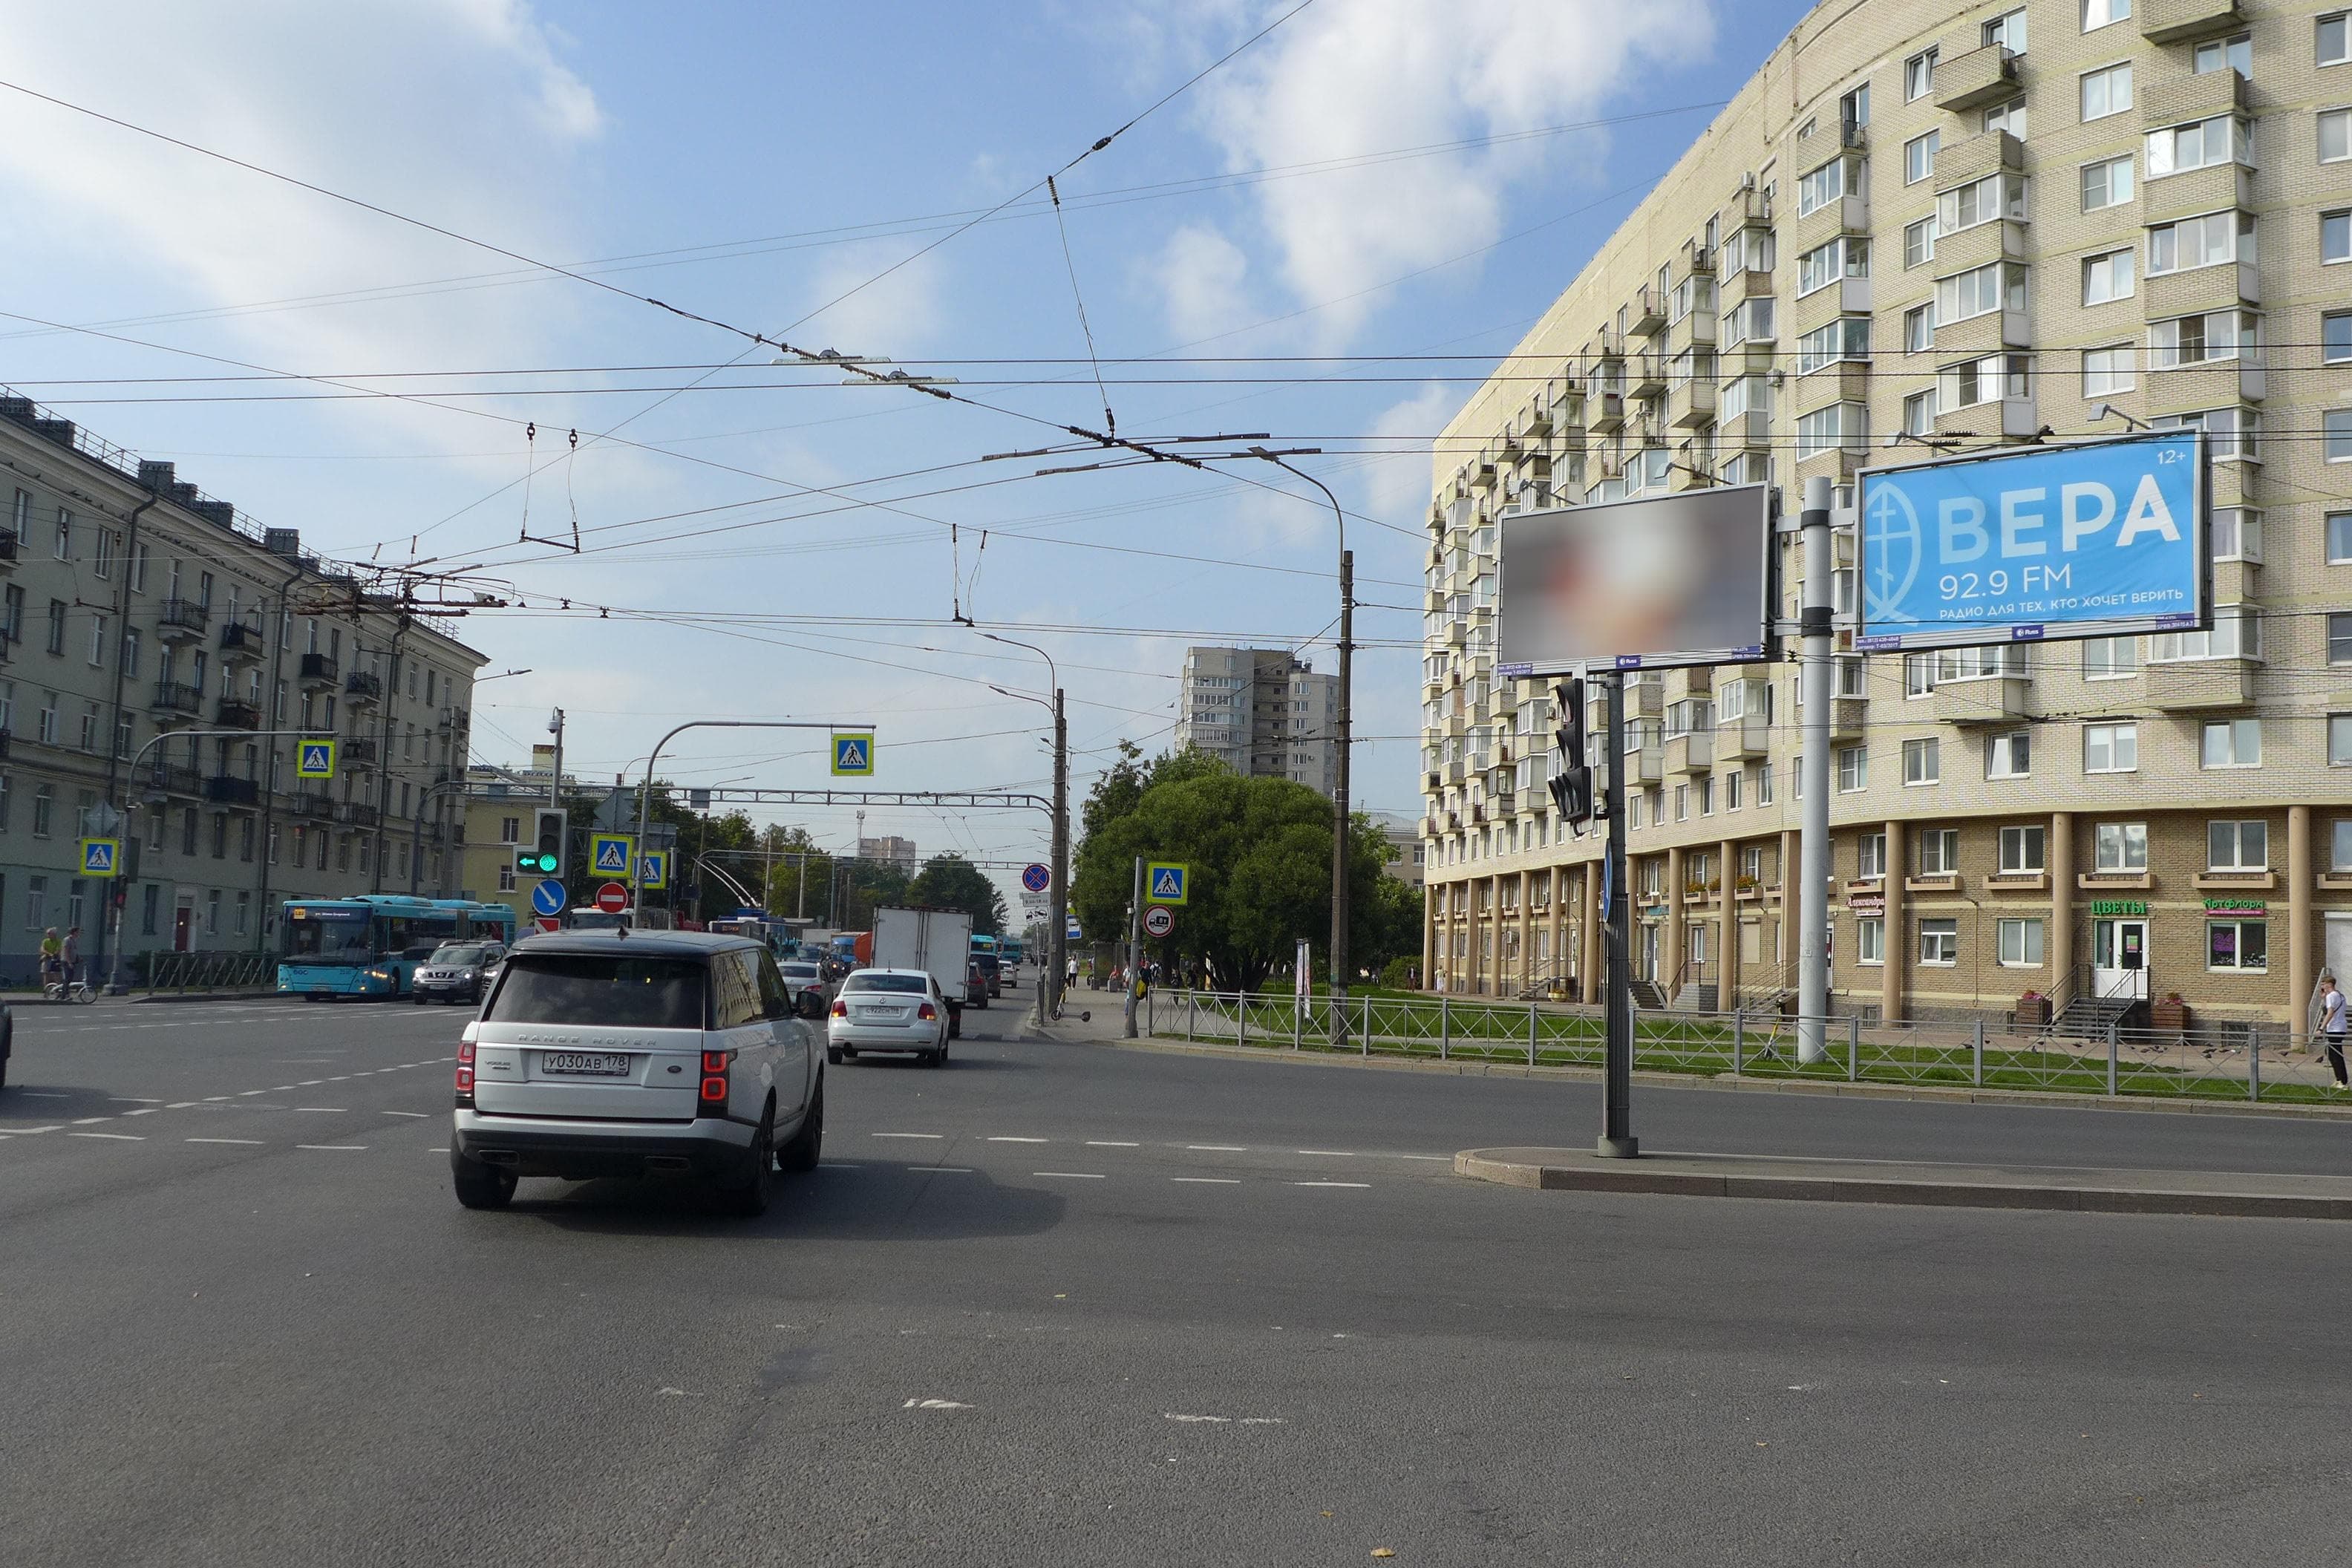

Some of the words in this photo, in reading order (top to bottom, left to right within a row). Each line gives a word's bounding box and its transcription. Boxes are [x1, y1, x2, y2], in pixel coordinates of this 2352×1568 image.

[2157, 450, 2186, 465] 12+
[1938, 474, 2181, 565] ВЕРА
[1939, 569, 2008, 601] 92.9
[2023, 564, 2071, 593] FM
[1940, 606, 1984, 619] РАДИО
[1987, 604, 2014, 617] ДЛЯ
[2019, 601, 2046, 612] ТЕХ,
[2051, 598, 2077, 610] КТО
[2082, 593, 2127, 607] ХОЧЕТ
[2132, 589, 2183, 604] ВЕРИТЬ
[1846, 895, 1885, 909] Александра
[2091, 899, 2146, 915] ЦВЕТЫ
[518, 1034, 580, 1043] RANGE
[549, 1054, 602, 1069] У030АВ
[605, 1055, 624, 1067] 178
